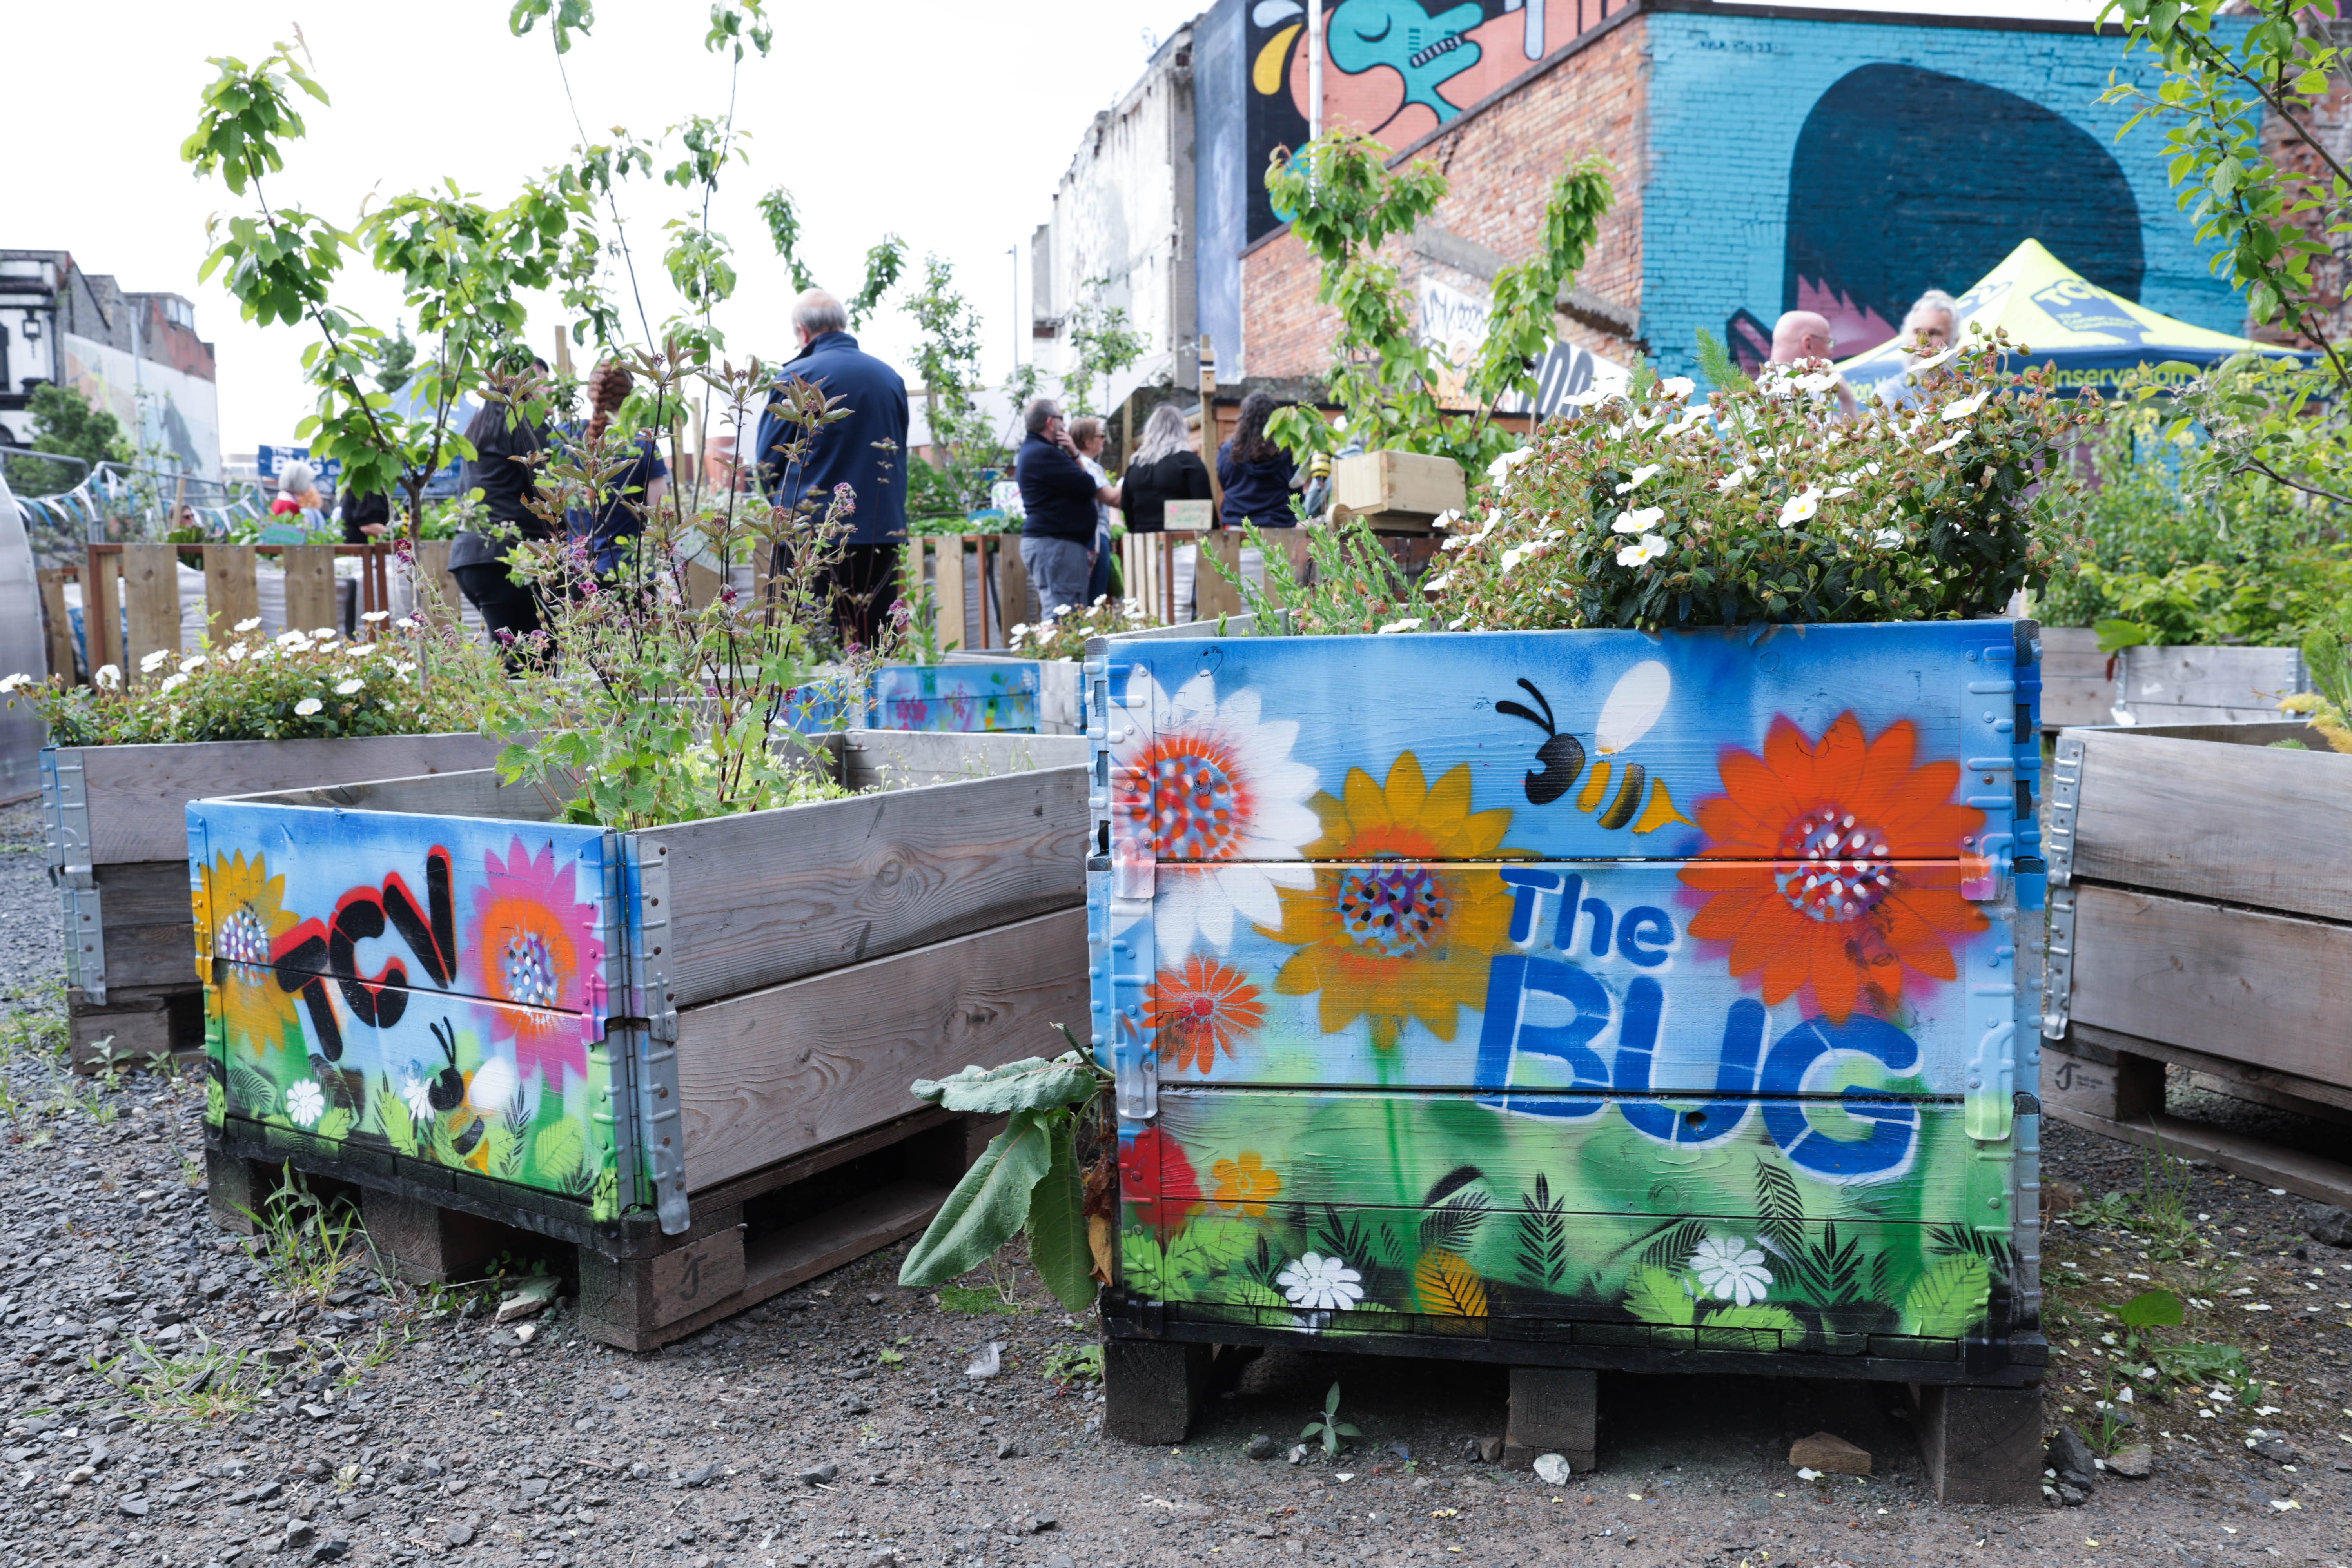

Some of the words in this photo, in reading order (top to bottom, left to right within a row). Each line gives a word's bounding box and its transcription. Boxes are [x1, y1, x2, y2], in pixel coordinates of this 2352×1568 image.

[269, 844, 458, 1062] TCV
[1499, 865, 1682, 975] The
[1473, 954, 1924, 1184] BUG
